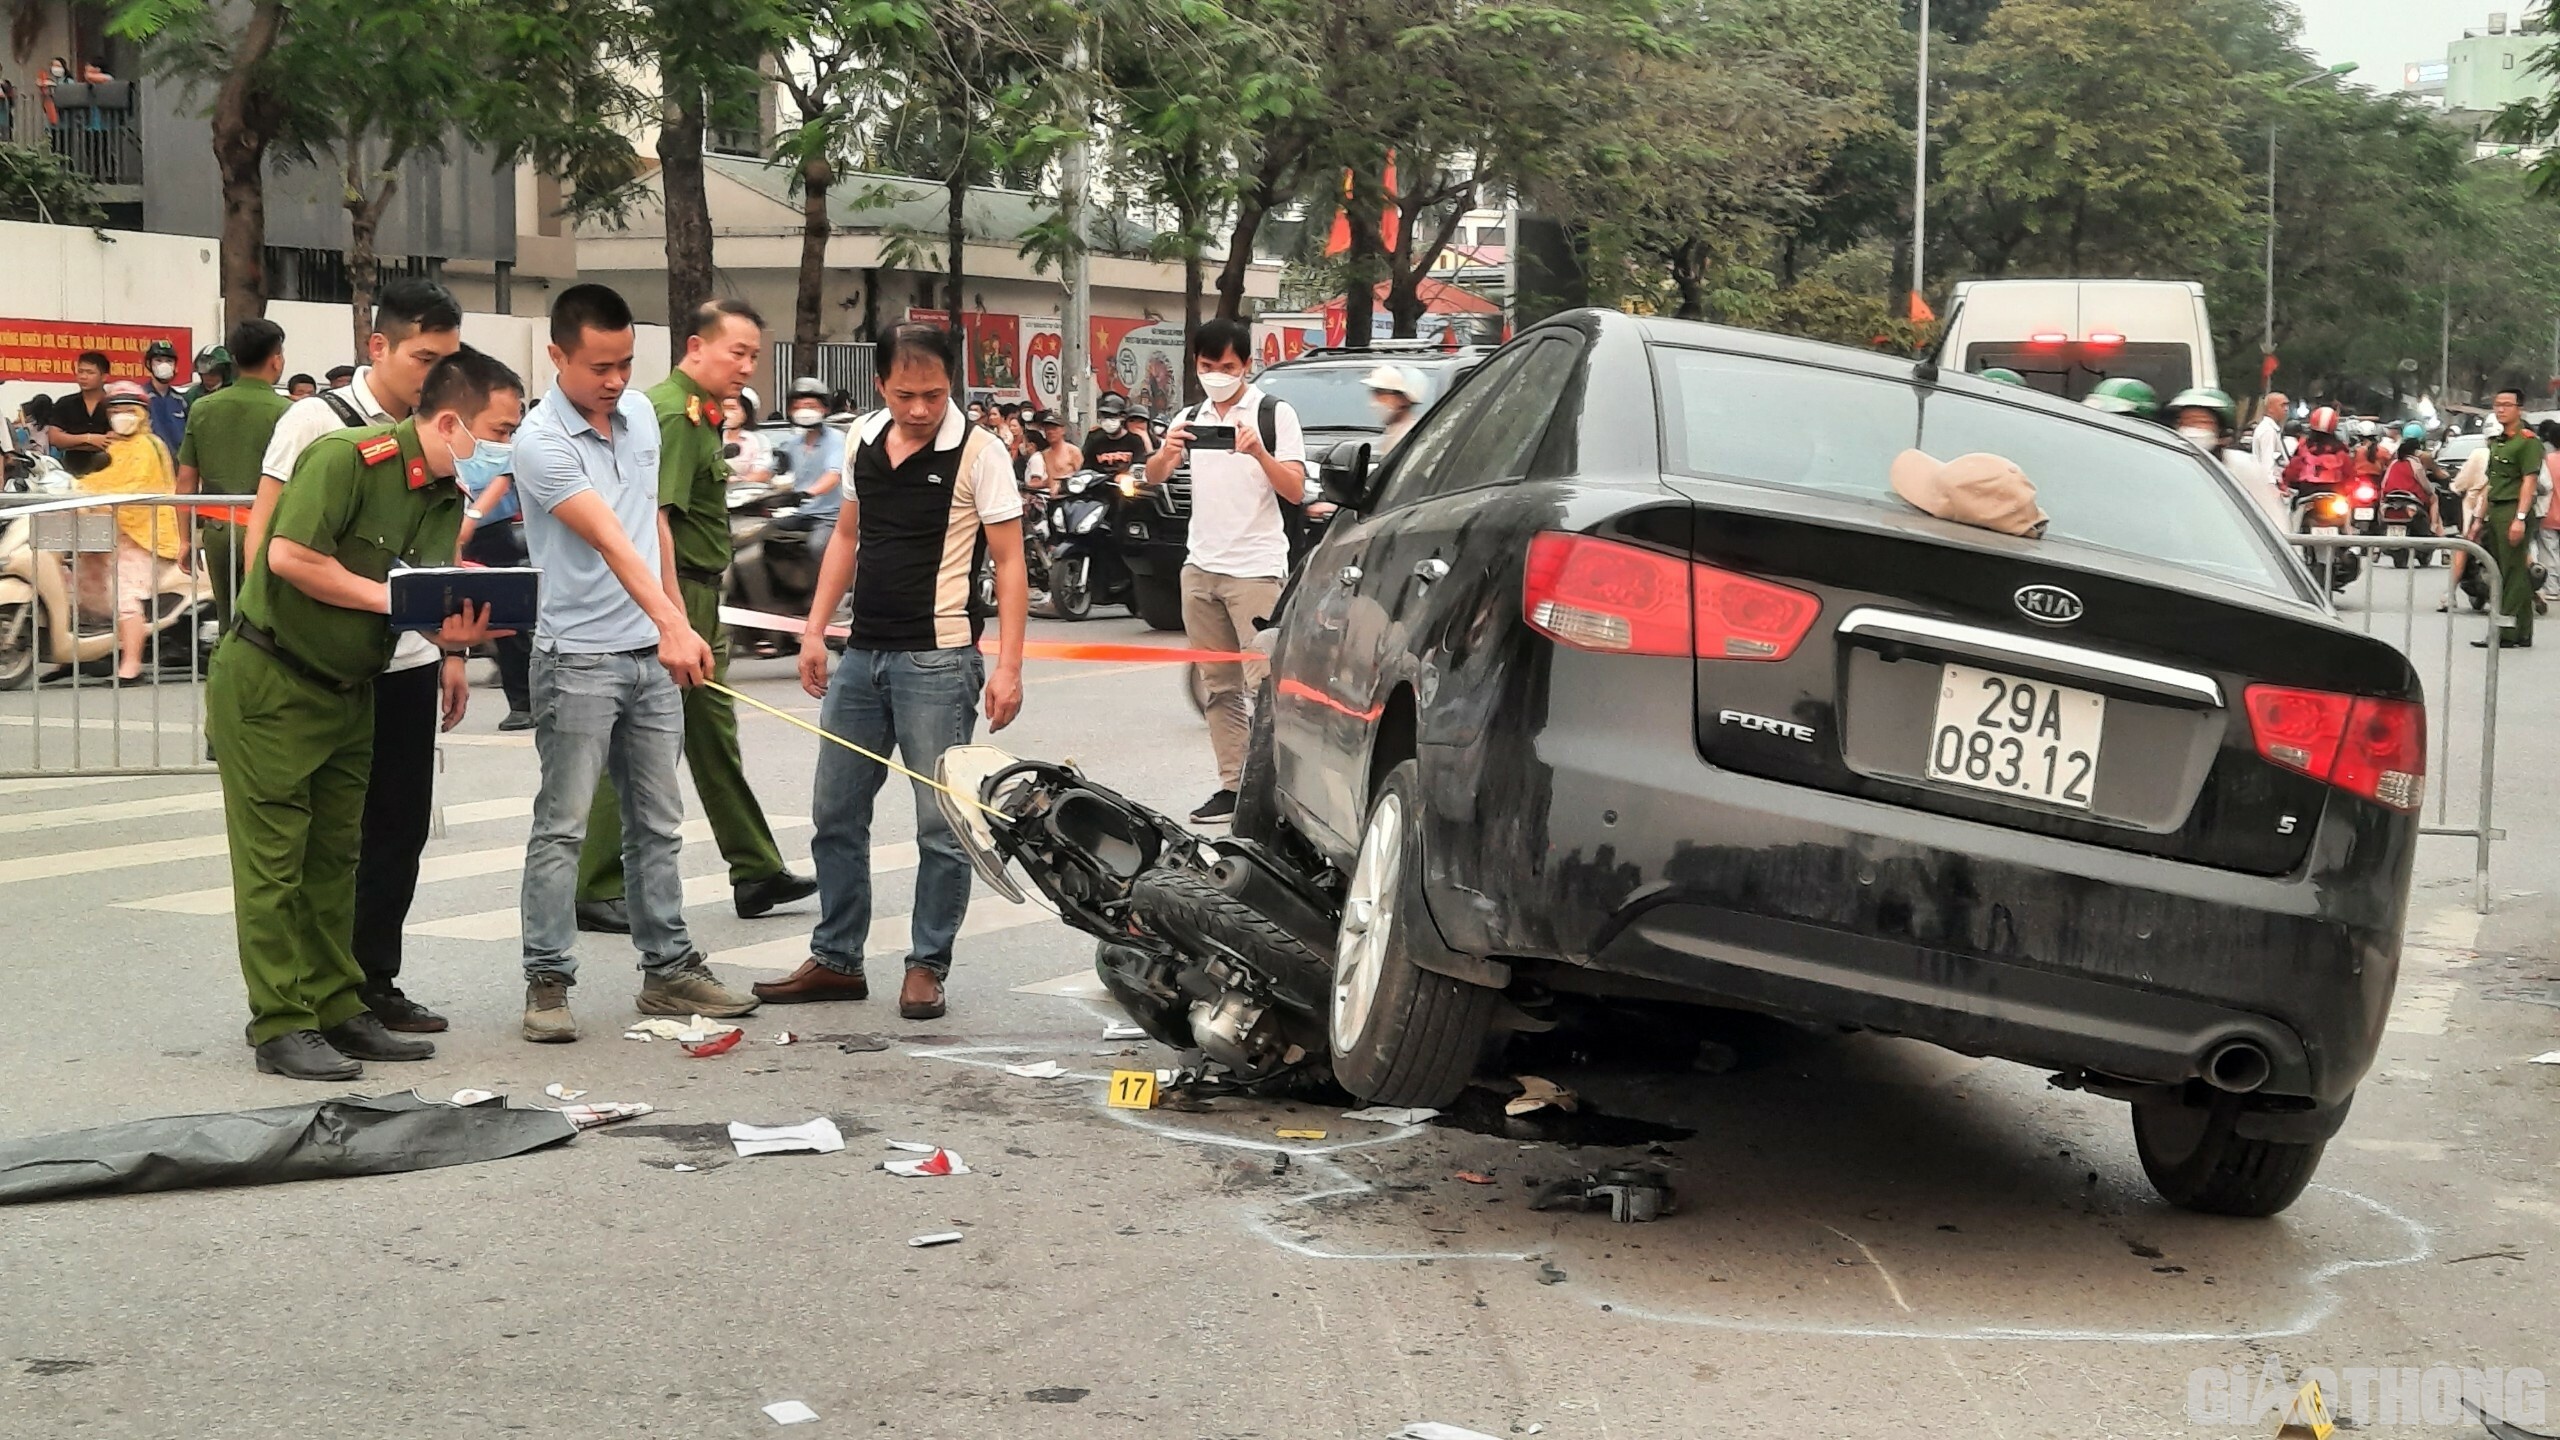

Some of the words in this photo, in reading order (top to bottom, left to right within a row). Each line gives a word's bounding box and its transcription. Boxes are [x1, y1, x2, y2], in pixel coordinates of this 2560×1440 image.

[2024, 588, 2073, 618] KIA
[1719, 708, 1817, 744] FORTE
[1977, 676, 2062, 742] 29A
[1935, 724, 2092, 803] 083.12
[1118, 1076, 1148, 1102] 17
